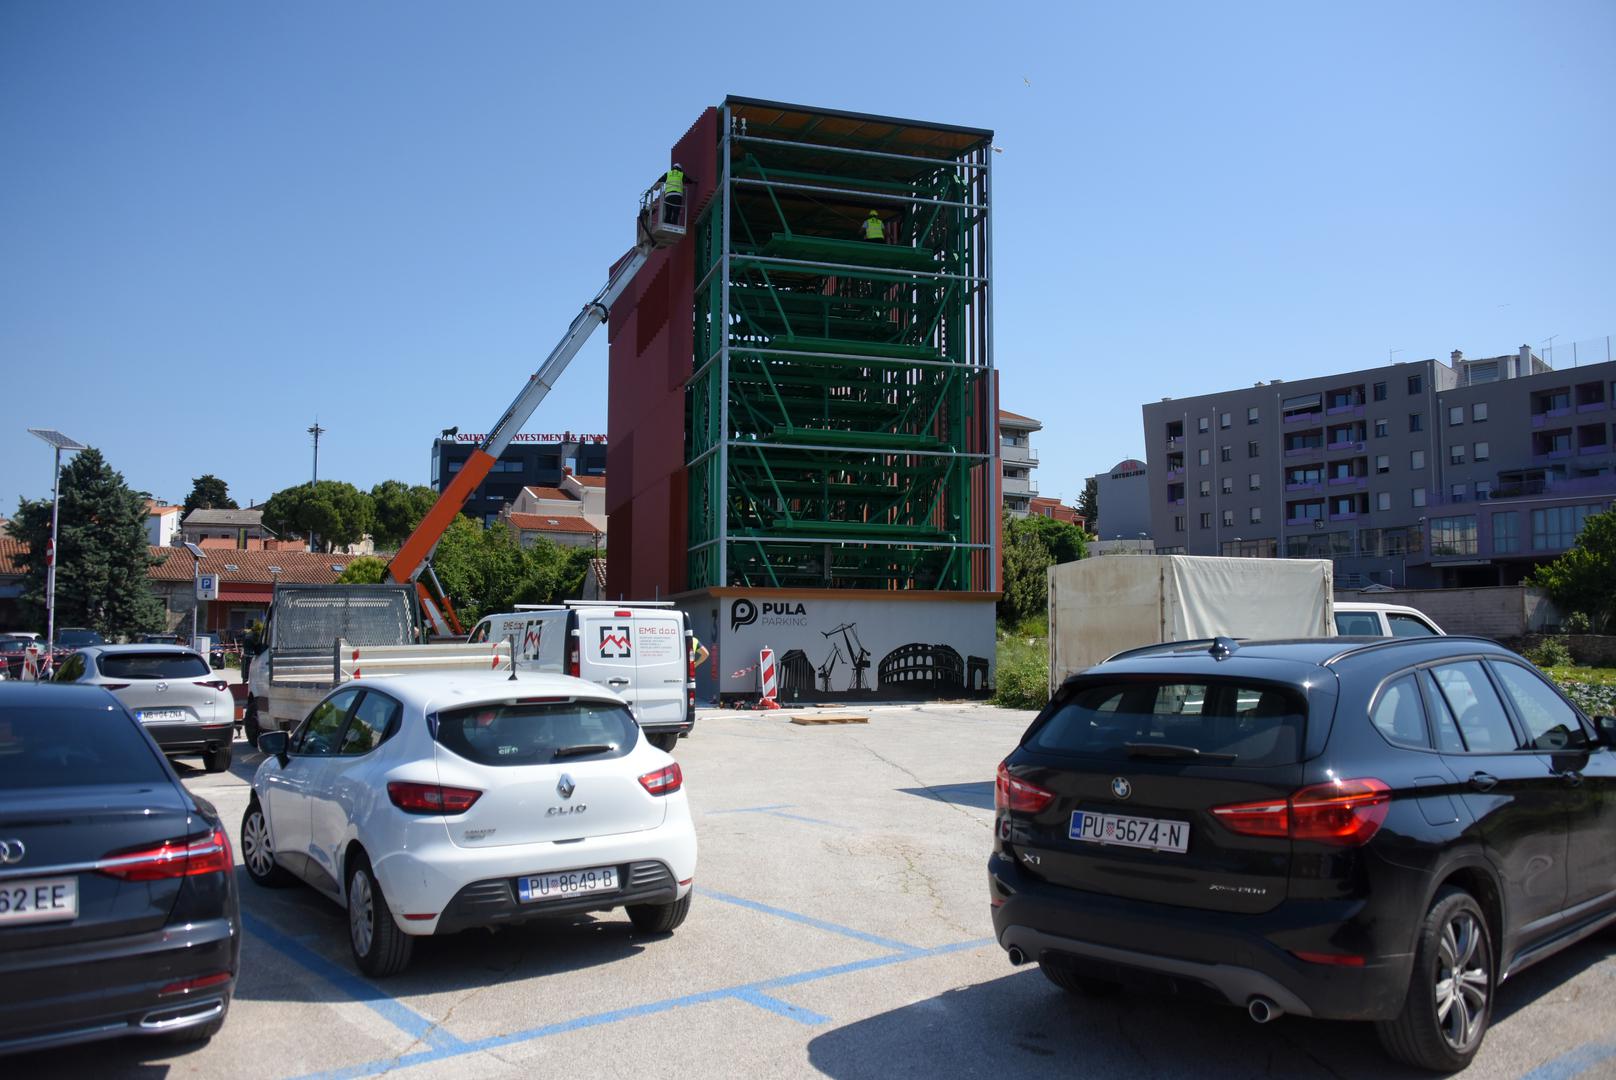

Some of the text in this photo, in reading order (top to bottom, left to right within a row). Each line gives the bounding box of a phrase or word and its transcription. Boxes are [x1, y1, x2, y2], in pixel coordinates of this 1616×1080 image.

[762, 603, 807, 615] PULA
[762, 617, 808, 626] PARKING
[547, 804, 587, 816] CLIO
[1082, 816, 1181, 847] PU 5674-N
[1023, 853, 1041, 865] X1
[530, 877, 550, 896] PU
[35, 885, 66, 909] EE
